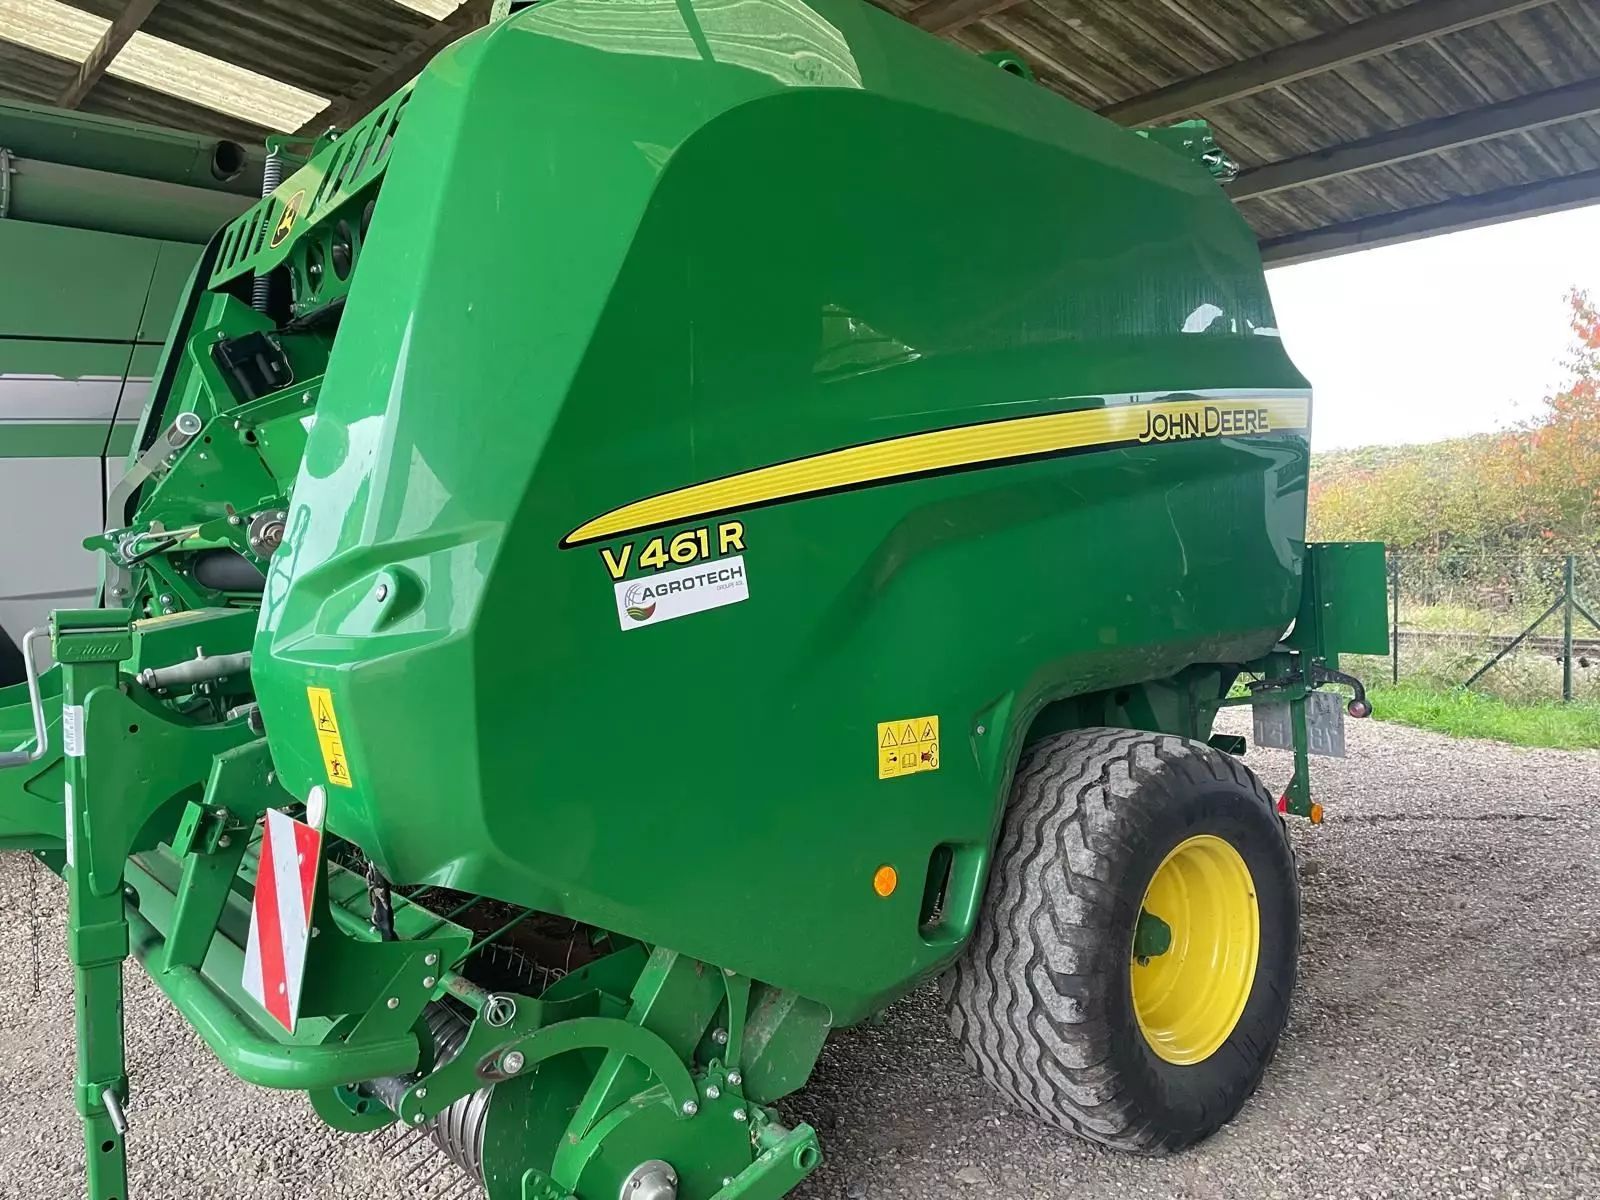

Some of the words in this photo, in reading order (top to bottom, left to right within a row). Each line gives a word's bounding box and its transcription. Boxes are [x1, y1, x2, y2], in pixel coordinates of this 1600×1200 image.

[1139, 409, 1200, 439] JOHN
[1204, 406, 1269, 434] DEERE
[600, 543, 633, 580] V
[638, 528, 710, 569] 461
[717, 520, 746, 554] R
[641, 565, 743, 601] AGROTECH
